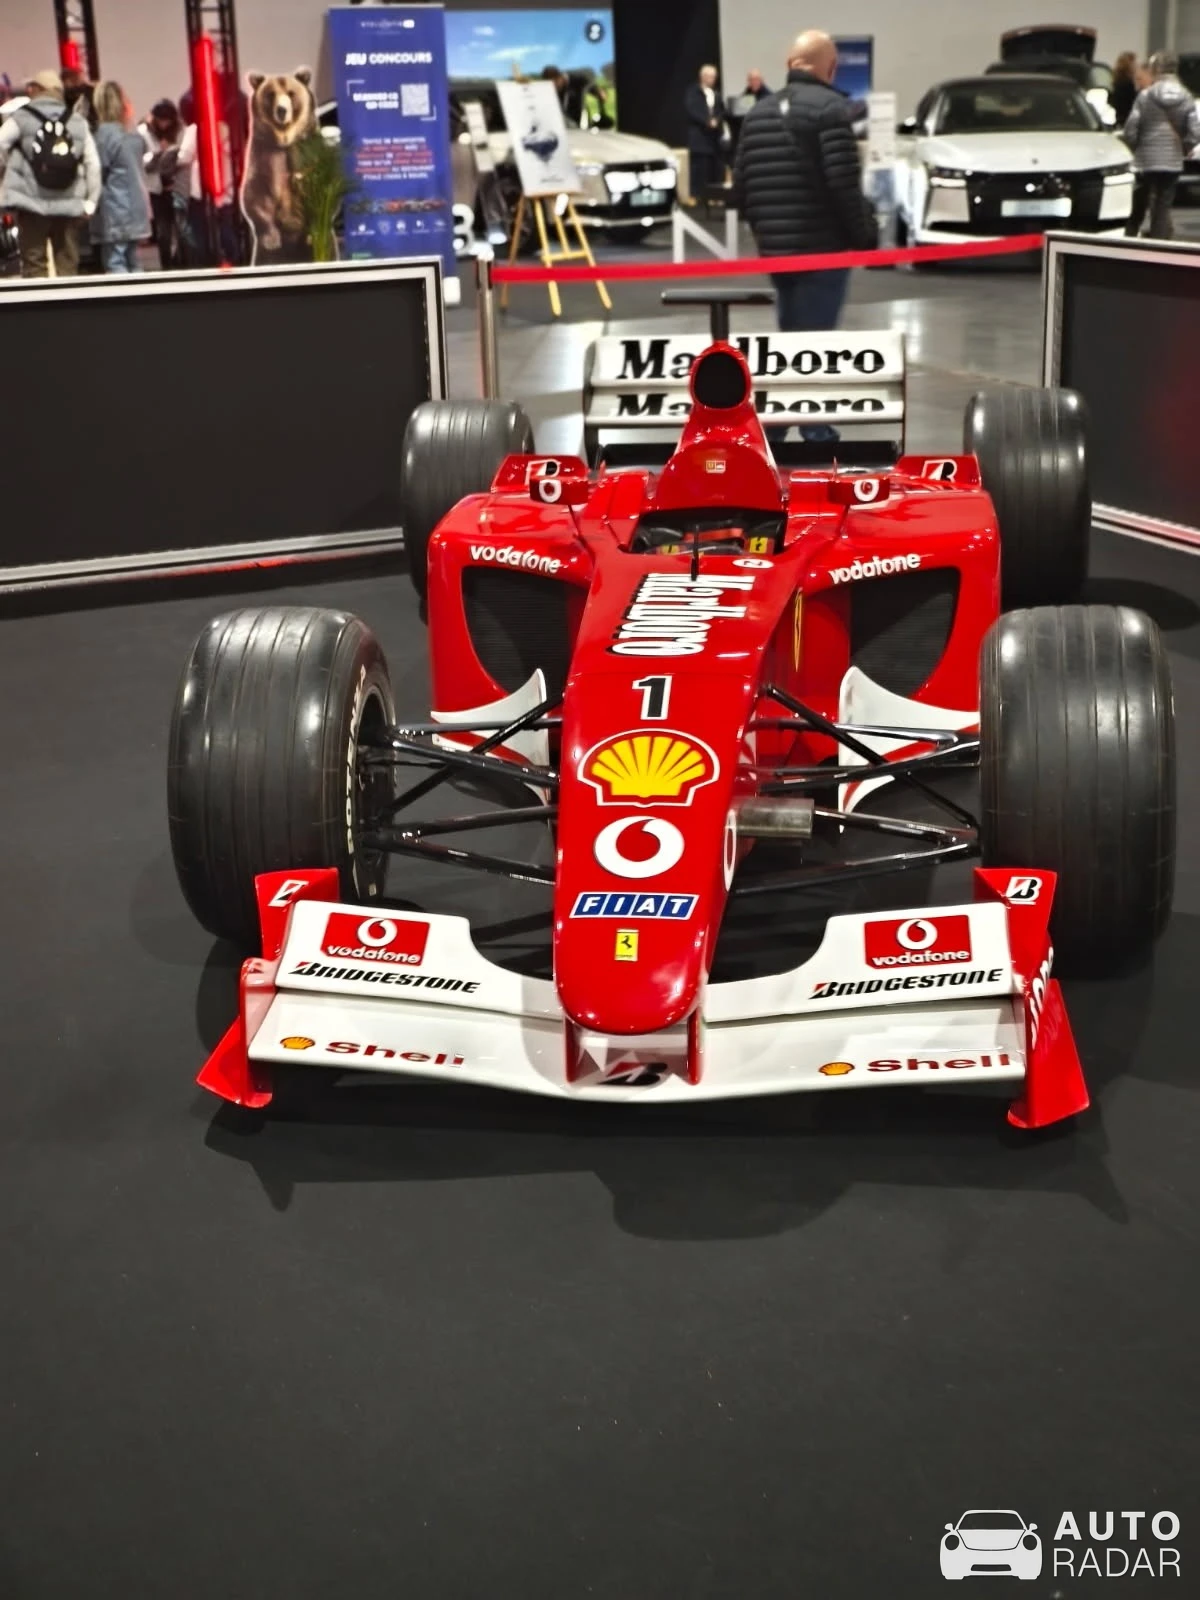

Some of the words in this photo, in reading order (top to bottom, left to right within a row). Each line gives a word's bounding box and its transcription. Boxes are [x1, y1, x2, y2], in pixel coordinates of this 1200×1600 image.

[345, 52, 367, 65] JEU
[369, 51, 432, 65] CONCOURS
[469, 544, 563, 574] vodafone
[828, 553, 921, 585] vodafone
[632, 675, 673, 720] 1
[578, 895, 693, 916] FIAT
[327, 944, 422, 965] vodafone
[872, 948, 970, 967] vodafone
[288, 961, 481, 994] BRIDGESTONE
[808, 968, 1004, 1000] BRIDGESTONE
[325, 1041, 465, 1067] Shell
[867, 1053, 1011, 1073] Shell
